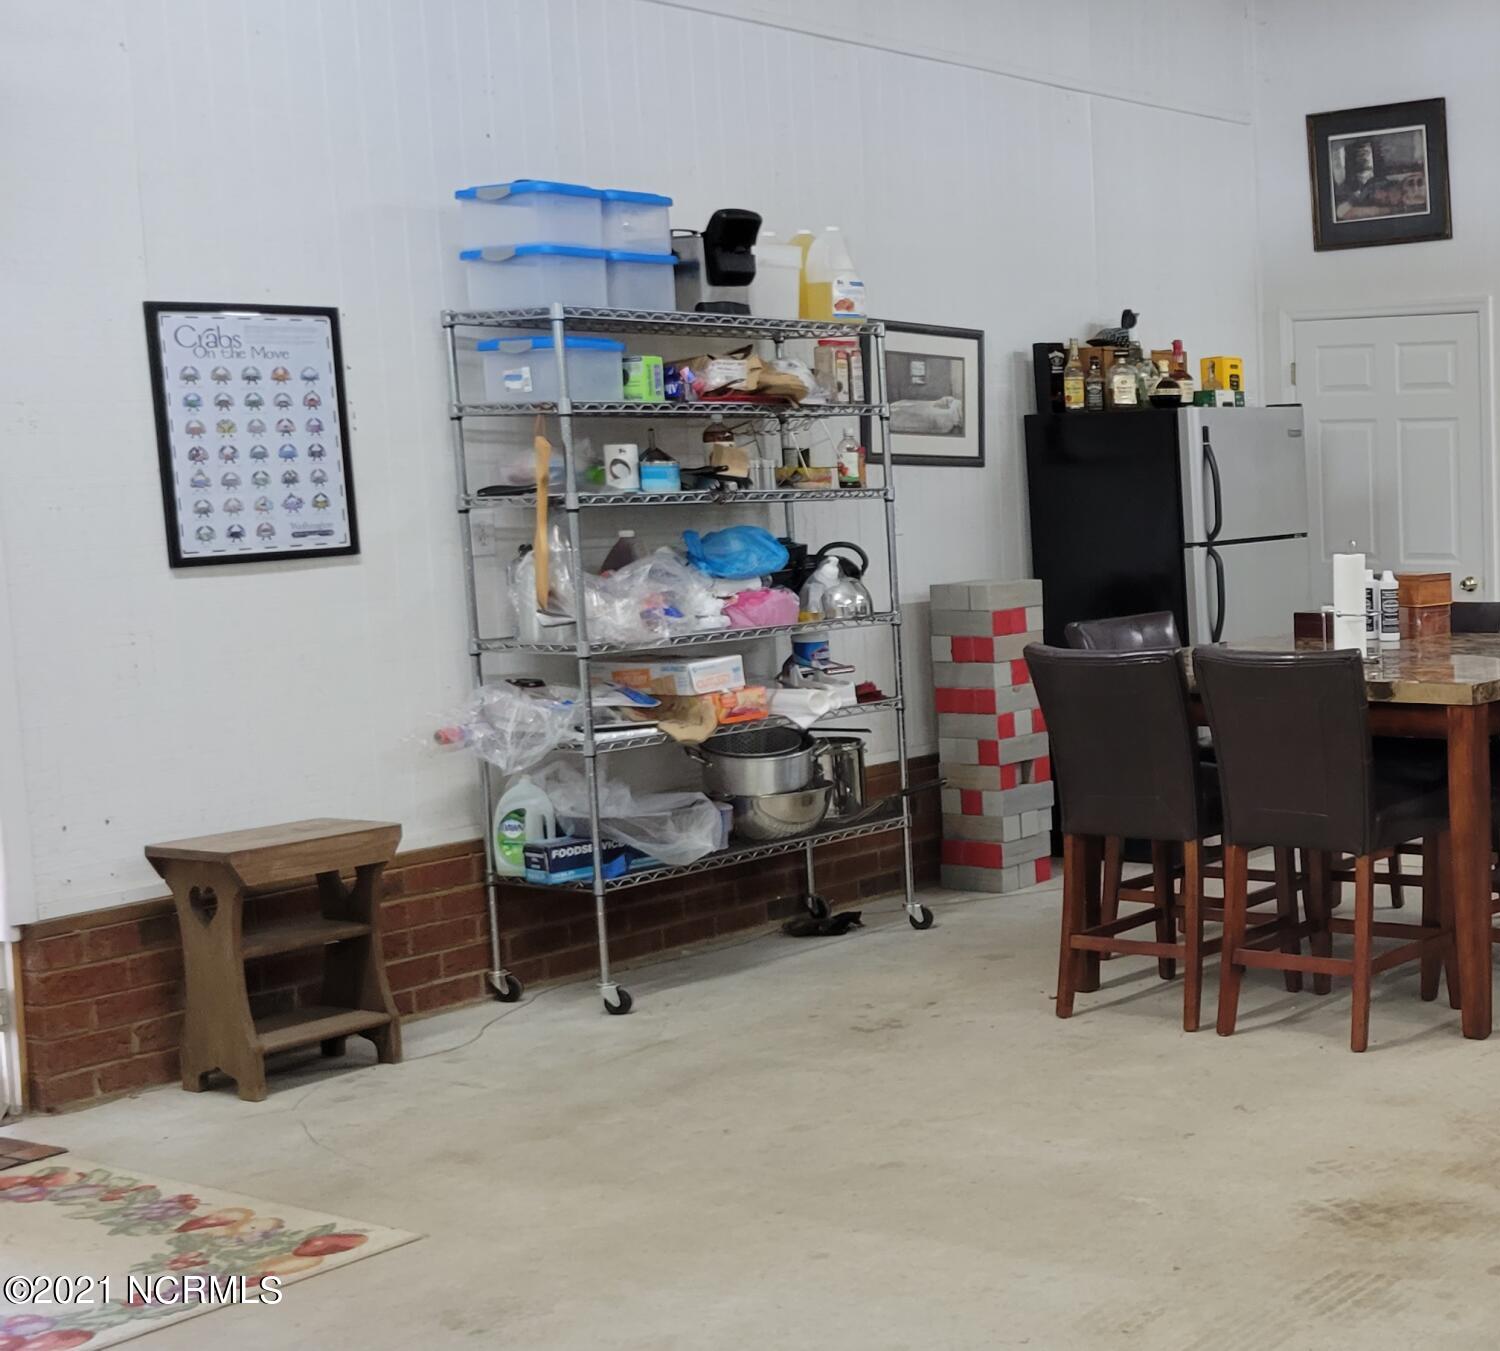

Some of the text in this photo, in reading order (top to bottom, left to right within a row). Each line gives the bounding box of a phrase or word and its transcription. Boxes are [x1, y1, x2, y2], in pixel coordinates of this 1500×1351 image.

[174, 324, 242, 349] Crabs
[193, 346, 290, 359] On the Move
